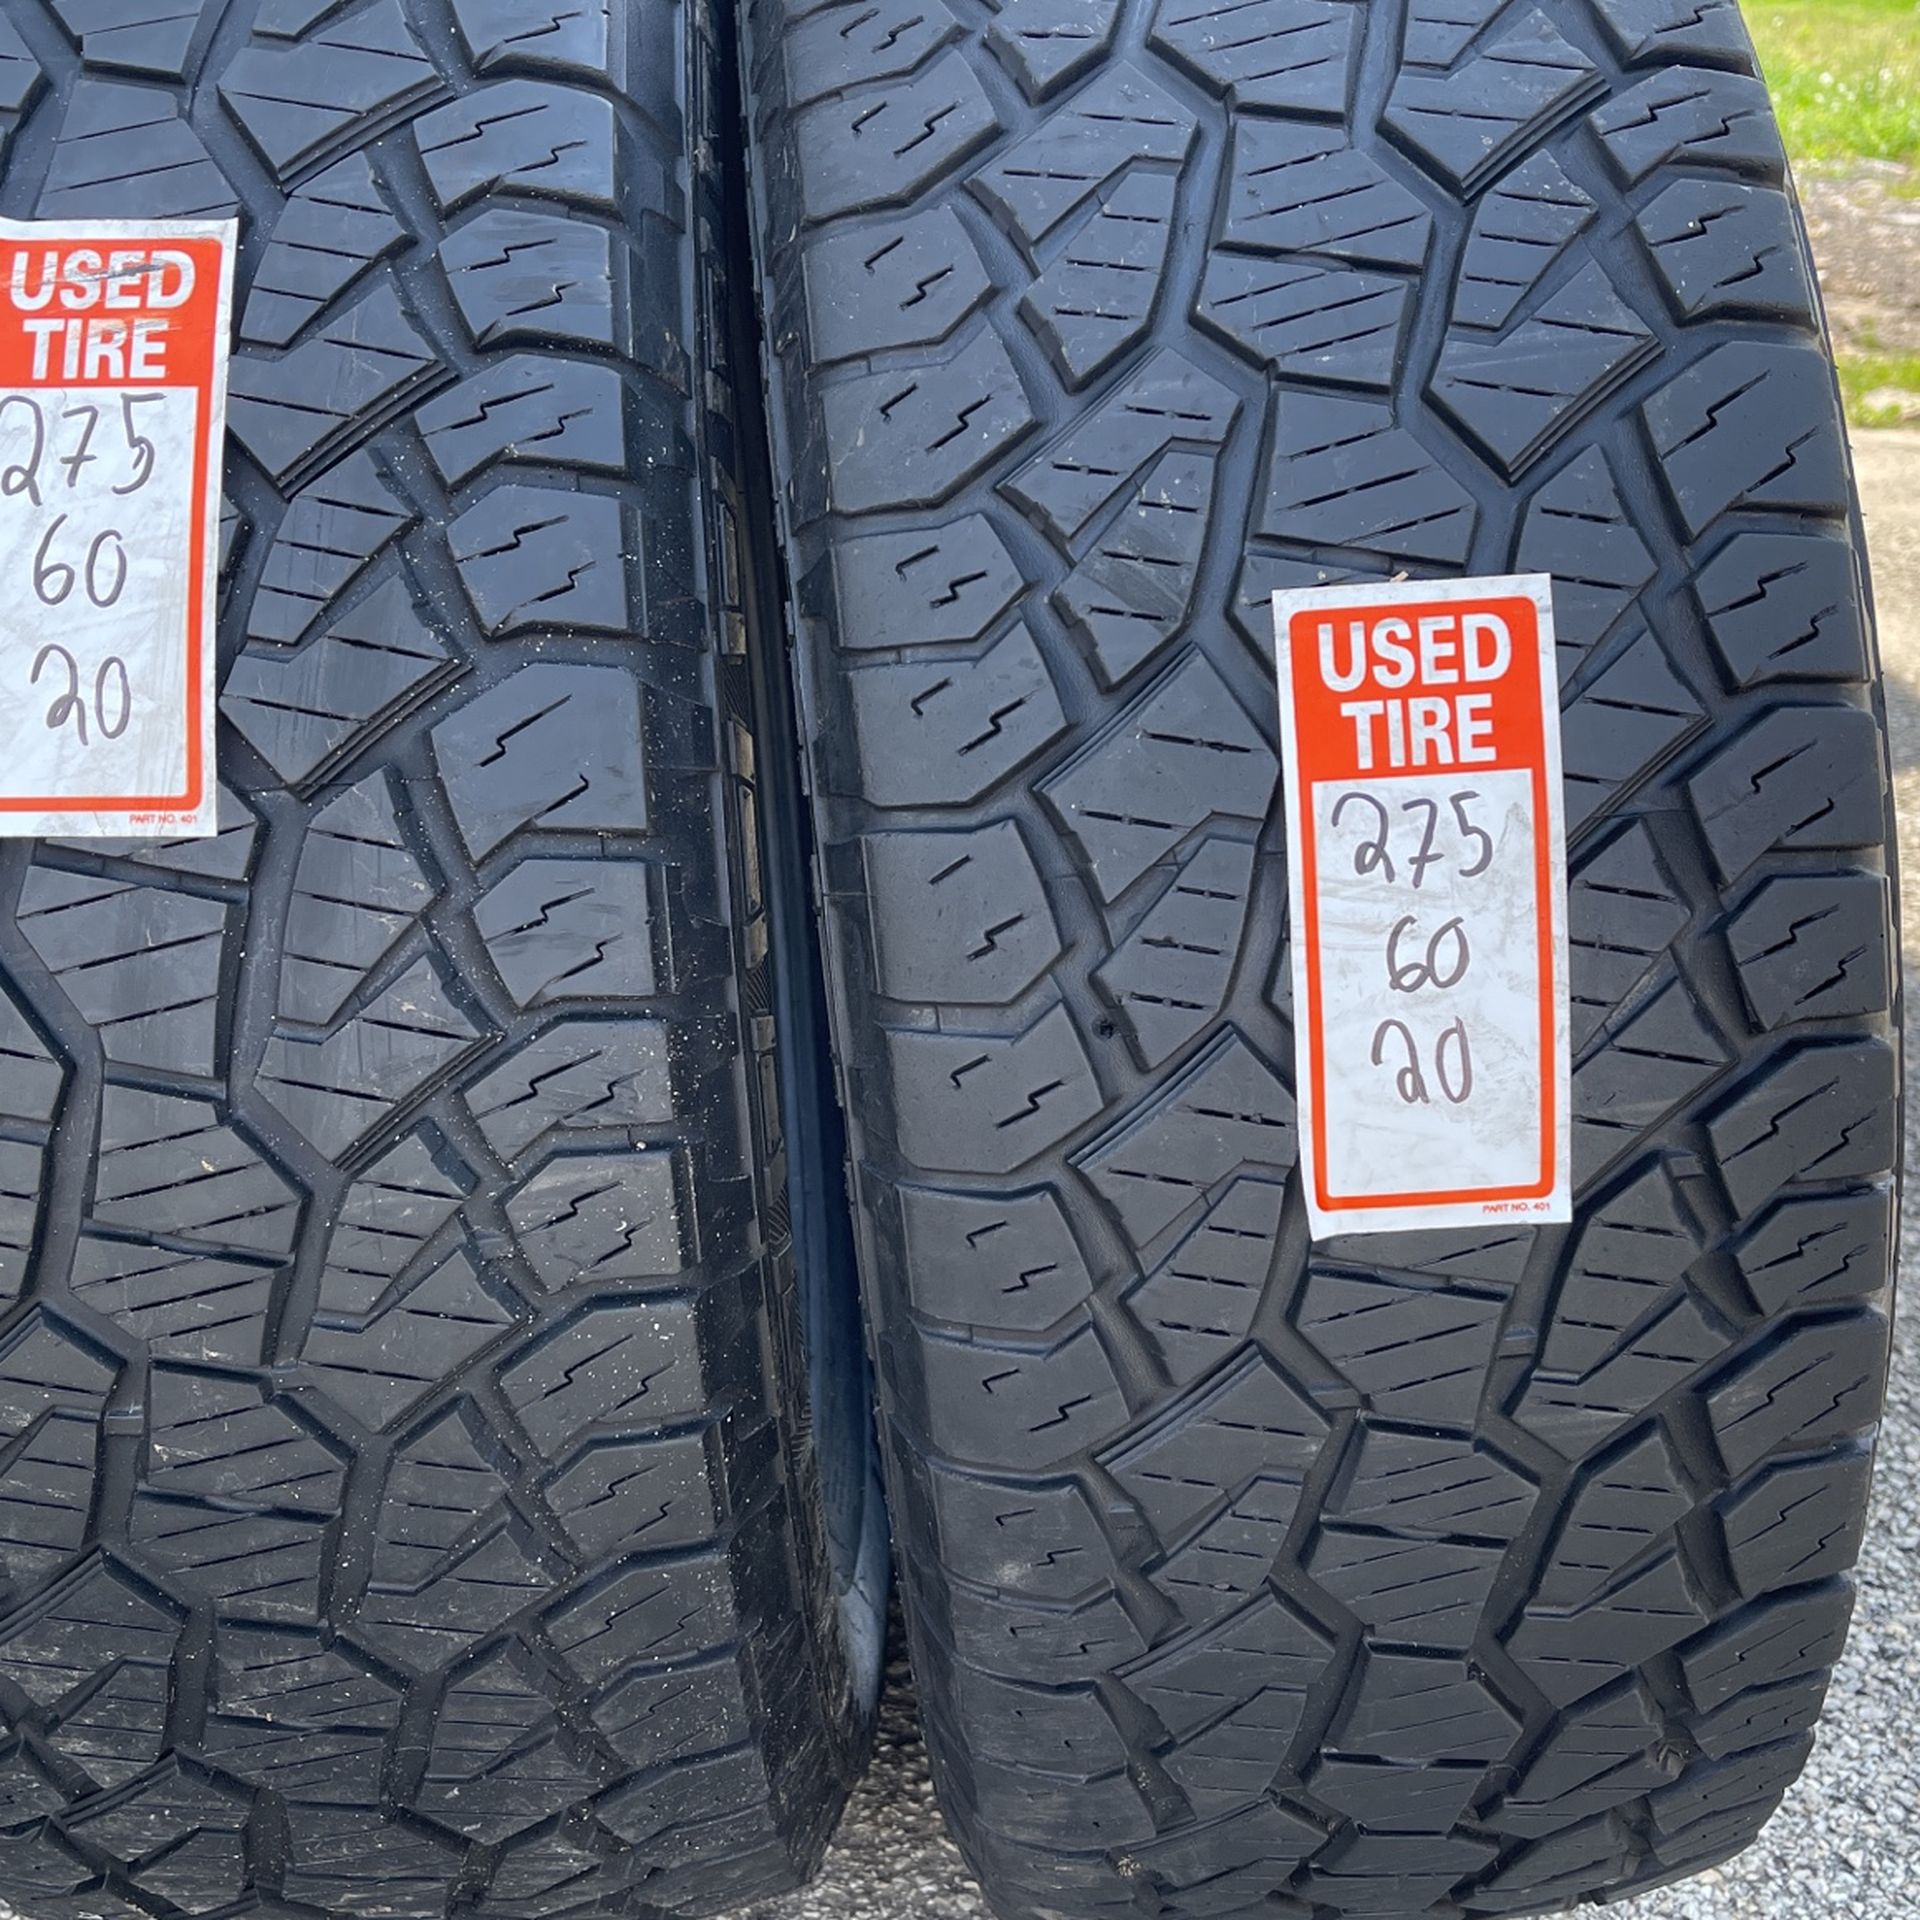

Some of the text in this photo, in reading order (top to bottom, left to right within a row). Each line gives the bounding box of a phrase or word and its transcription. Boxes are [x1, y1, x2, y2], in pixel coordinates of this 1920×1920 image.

[10, 249, 196, 311] USED
[22, 318, 170, 380] TIRE
[0, 392, 167, 507] 275
[33, 513, 127, 608] 60
[1317, 612, 1512, 693] USED
[31, 643, 132, 746] 20
[1340, 692, 1497, 770] TIRE
[129, 813, 156, 825] PART
[180, 813, 198, 824] 401
[1331, 790, 1494, 889] 275
[1386, 914, 1471, 993] 60
[1370, 1015, 1473, 1104] 20
[1482, 1201, 1551, 1214] PART NO. 401
